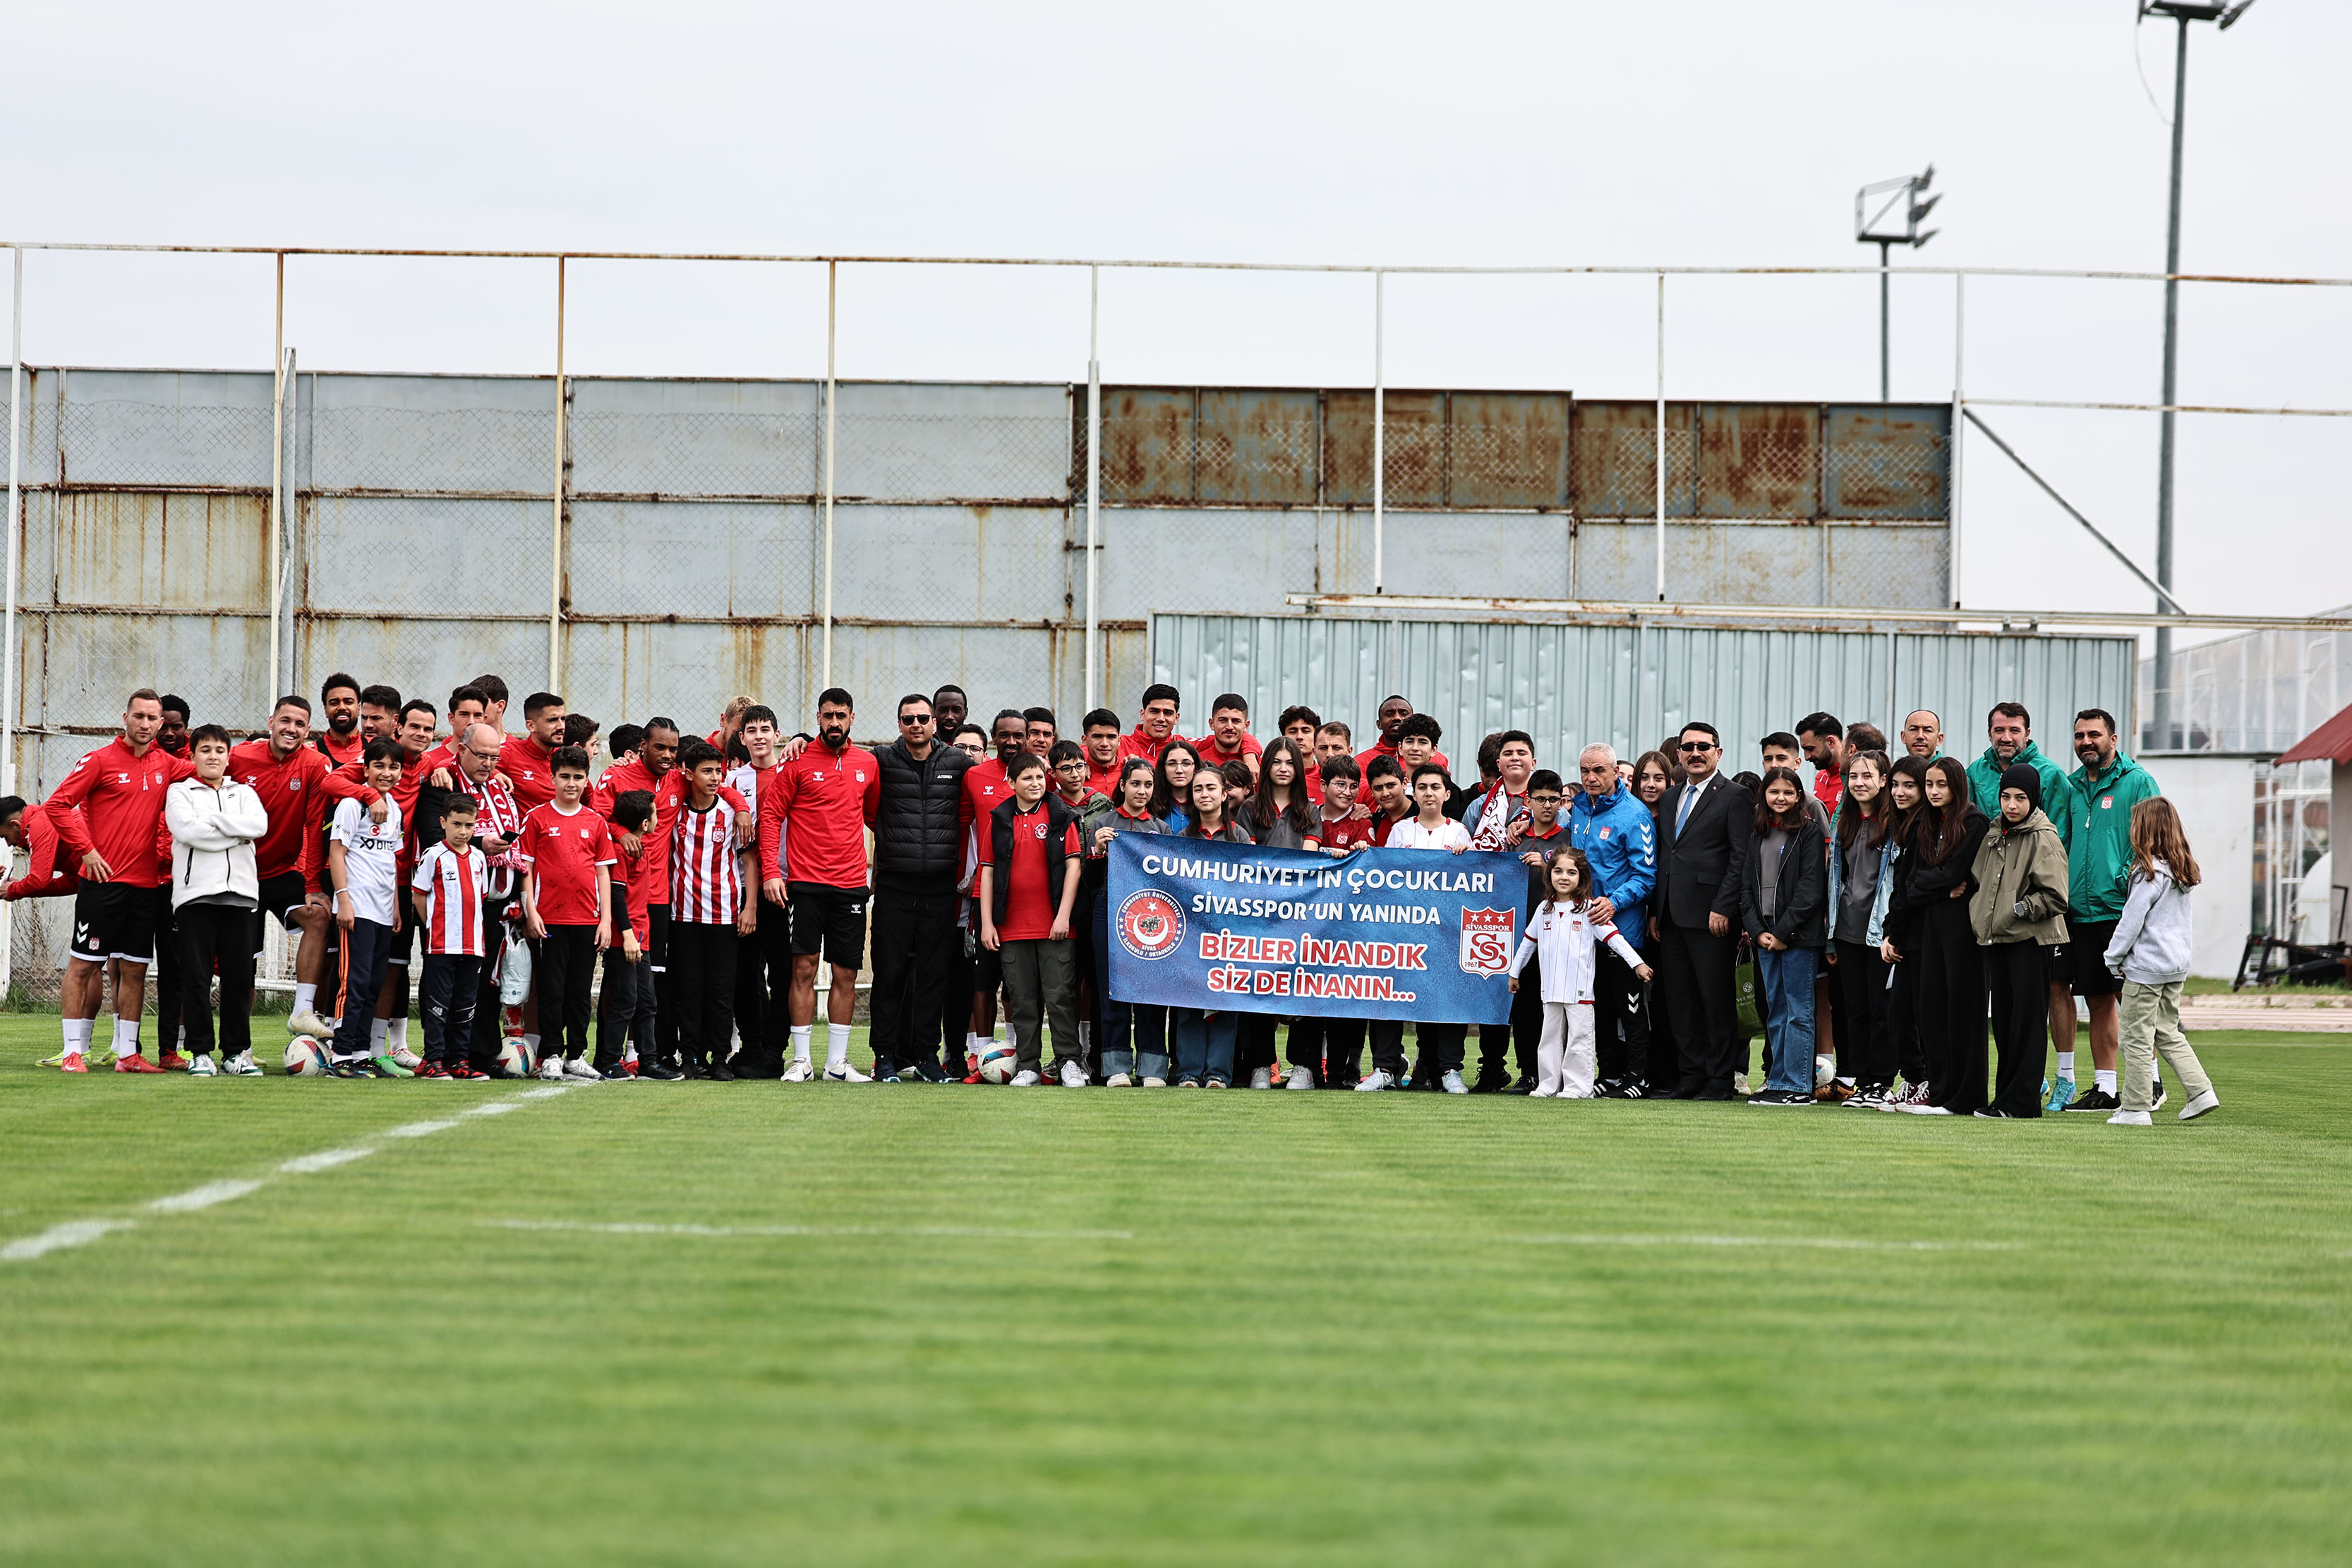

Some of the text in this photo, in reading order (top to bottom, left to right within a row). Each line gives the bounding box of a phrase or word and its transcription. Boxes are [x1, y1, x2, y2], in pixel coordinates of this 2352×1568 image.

[1142, 855, 1494, 894] CUMHURİYET'İN ÇOCUKLARI
[1121, 891, 1183, 918] CUMHURİYET ÜNİVERSİTESİ
[1192, 891, 1441, 925] SİVASSPOR'UN YANINDA
[1465, 922, 1510, 931] SİVASSPOR
[1123, 937, 1144, 955] İLKOKULU
[1148, 942, 1176, 957] ORTAOKULU
[1200, 929, 1427, 969] BİZLER İNANDIK
[1208, 964, 1415, 1001] SİZ DE İNANIN...
